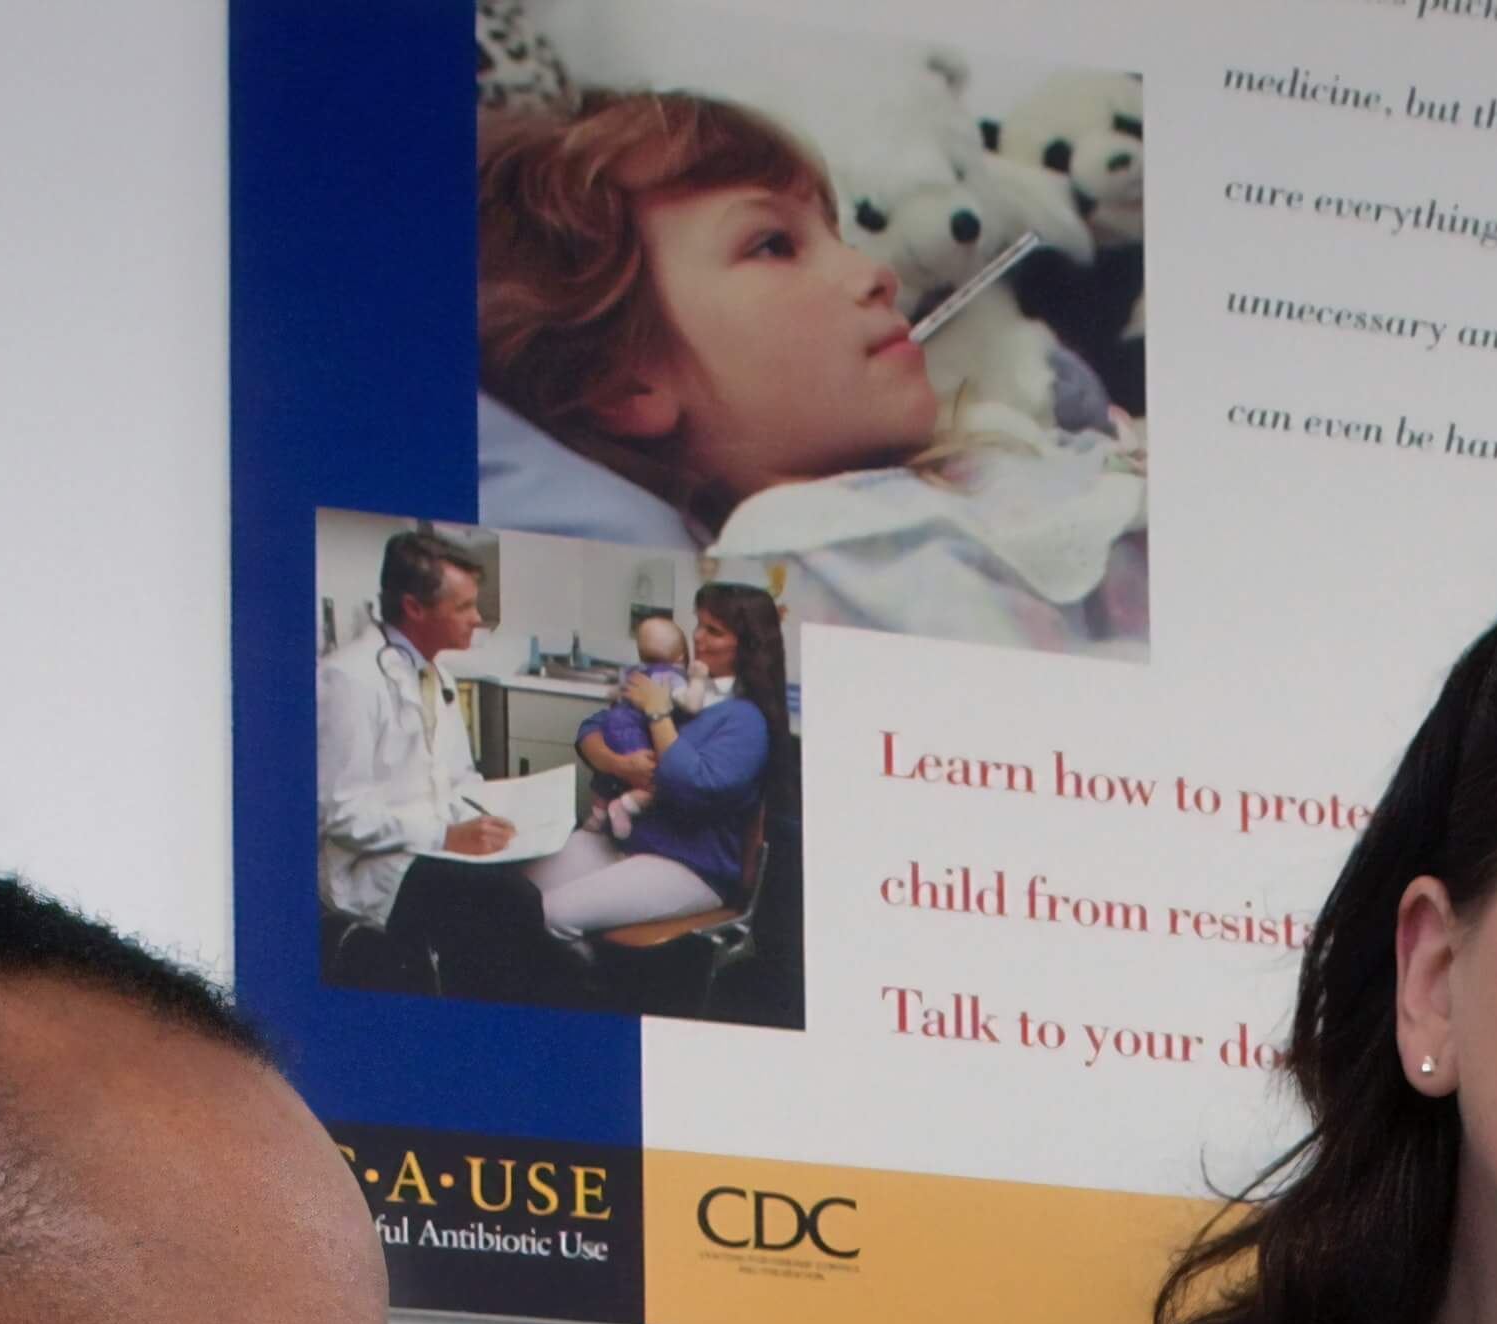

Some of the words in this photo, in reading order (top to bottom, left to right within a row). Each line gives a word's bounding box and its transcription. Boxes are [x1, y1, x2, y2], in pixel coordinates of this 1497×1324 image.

[1223, 66, 1393, 118] medicine,
[1405, 86, 1461, 125] but
[1223, 179, 1304, 210] cure
[1226, 288, 1448, 350] unnecessary
[1226, 402, 1292, 434] can
[1303, 415, 1383, 446] even
[1394, 416, 1435, 450] be
[878, 729, 1037, 794] Learn
[1052, 750, 1157, 808] how
[1175, 775, 1222, 816] to
[1238, 787, 1373, 833] prote
[879, 859, 1008, 919] child
[1026, 873, 1150, 934] from
[880, 984, 1001, 1045] Talk
[1018, 1010, 1065, 1051] to
[1081, 1024, 1206, 1069] your
[1218, 1021, 1280, 1072] do
[417, 1218, 552, 1258] Antibiotic
[559, 1230, 610, 1263] Use
[696, 1185, 861, 1260] CDC
